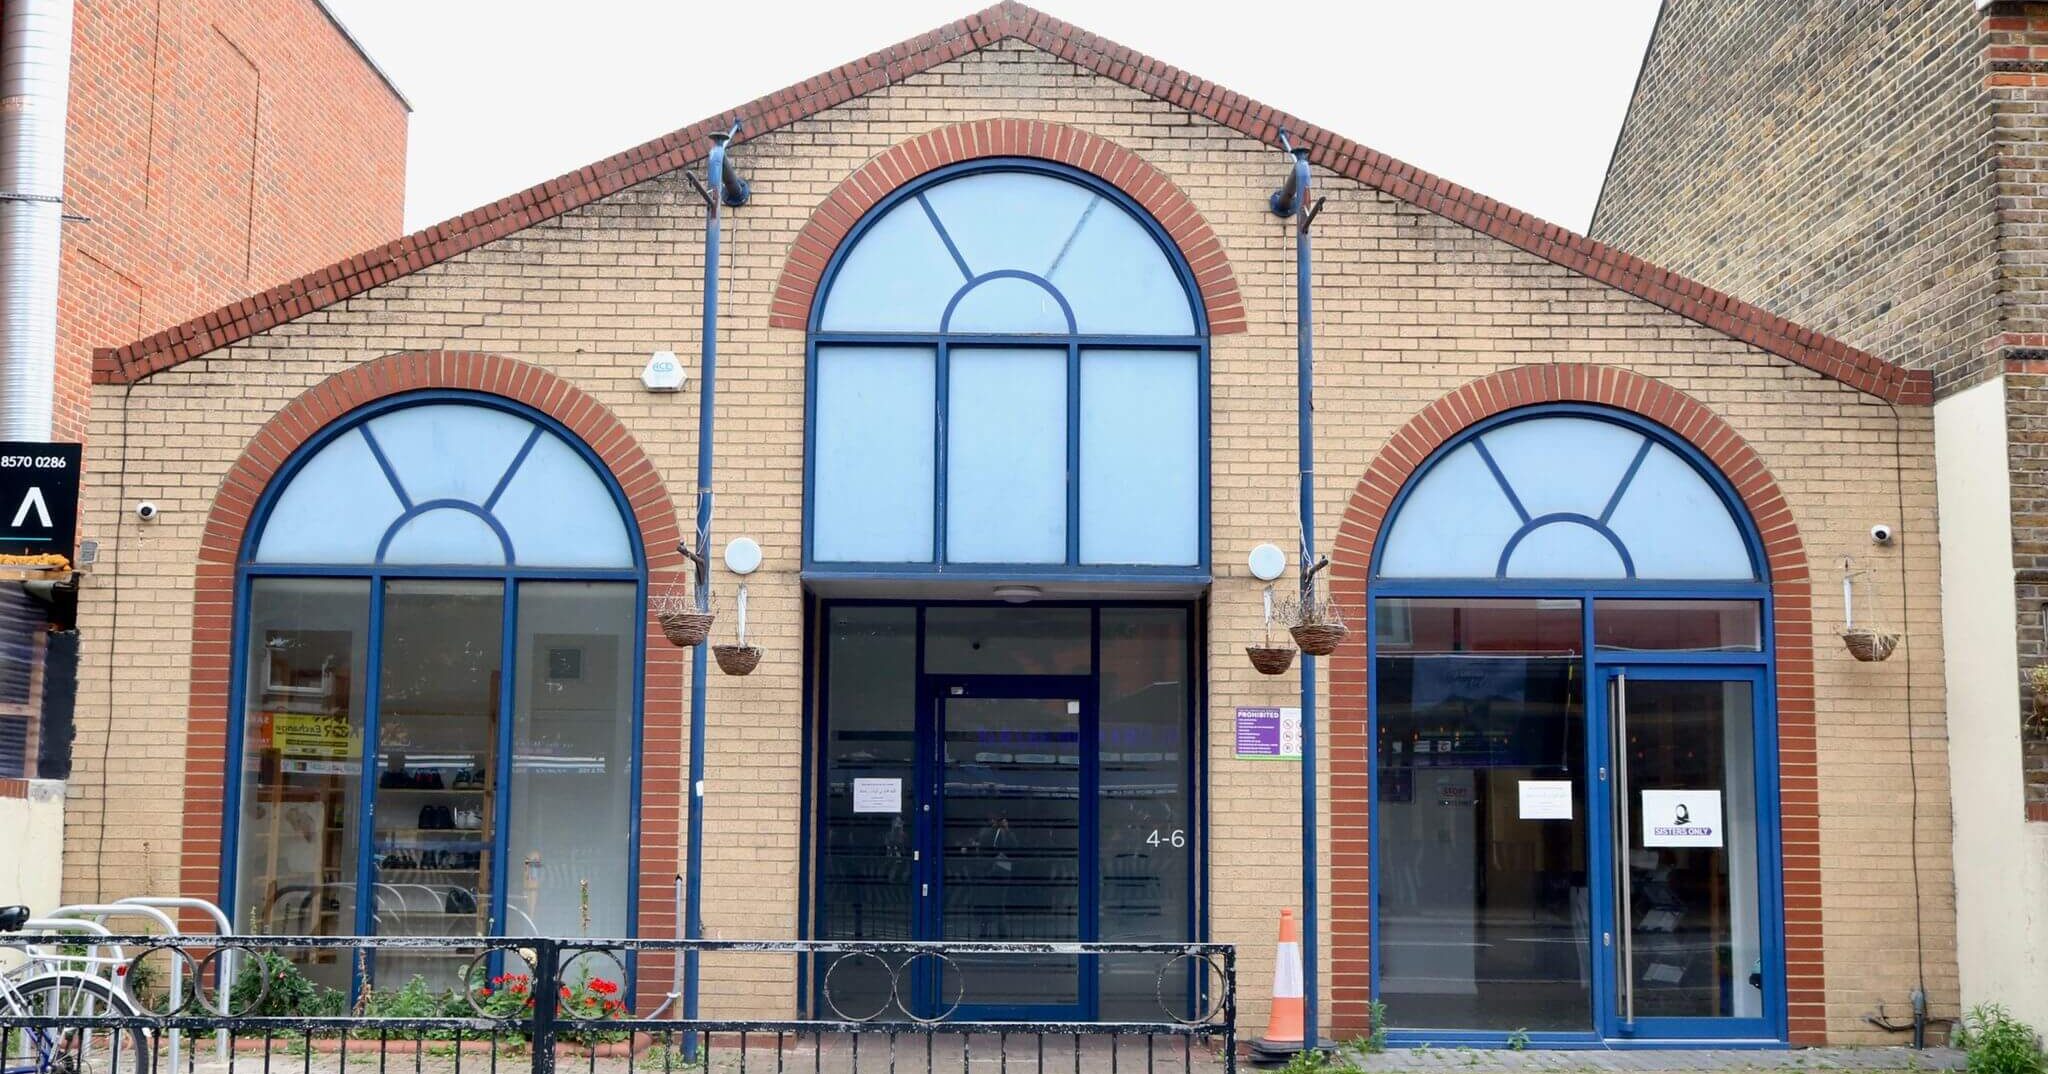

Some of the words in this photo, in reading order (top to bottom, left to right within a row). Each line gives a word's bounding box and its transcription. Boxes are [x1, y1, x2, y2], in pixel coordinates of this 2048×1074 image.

[1, 456, 32, 467] 8570
[35, 456, 66, 468] 0286
[1655, 827, 1687, 836] SISTERS
[1688, 827, 1708, 836] ONLY
[1146, 829, 1185, 848] 4-6
